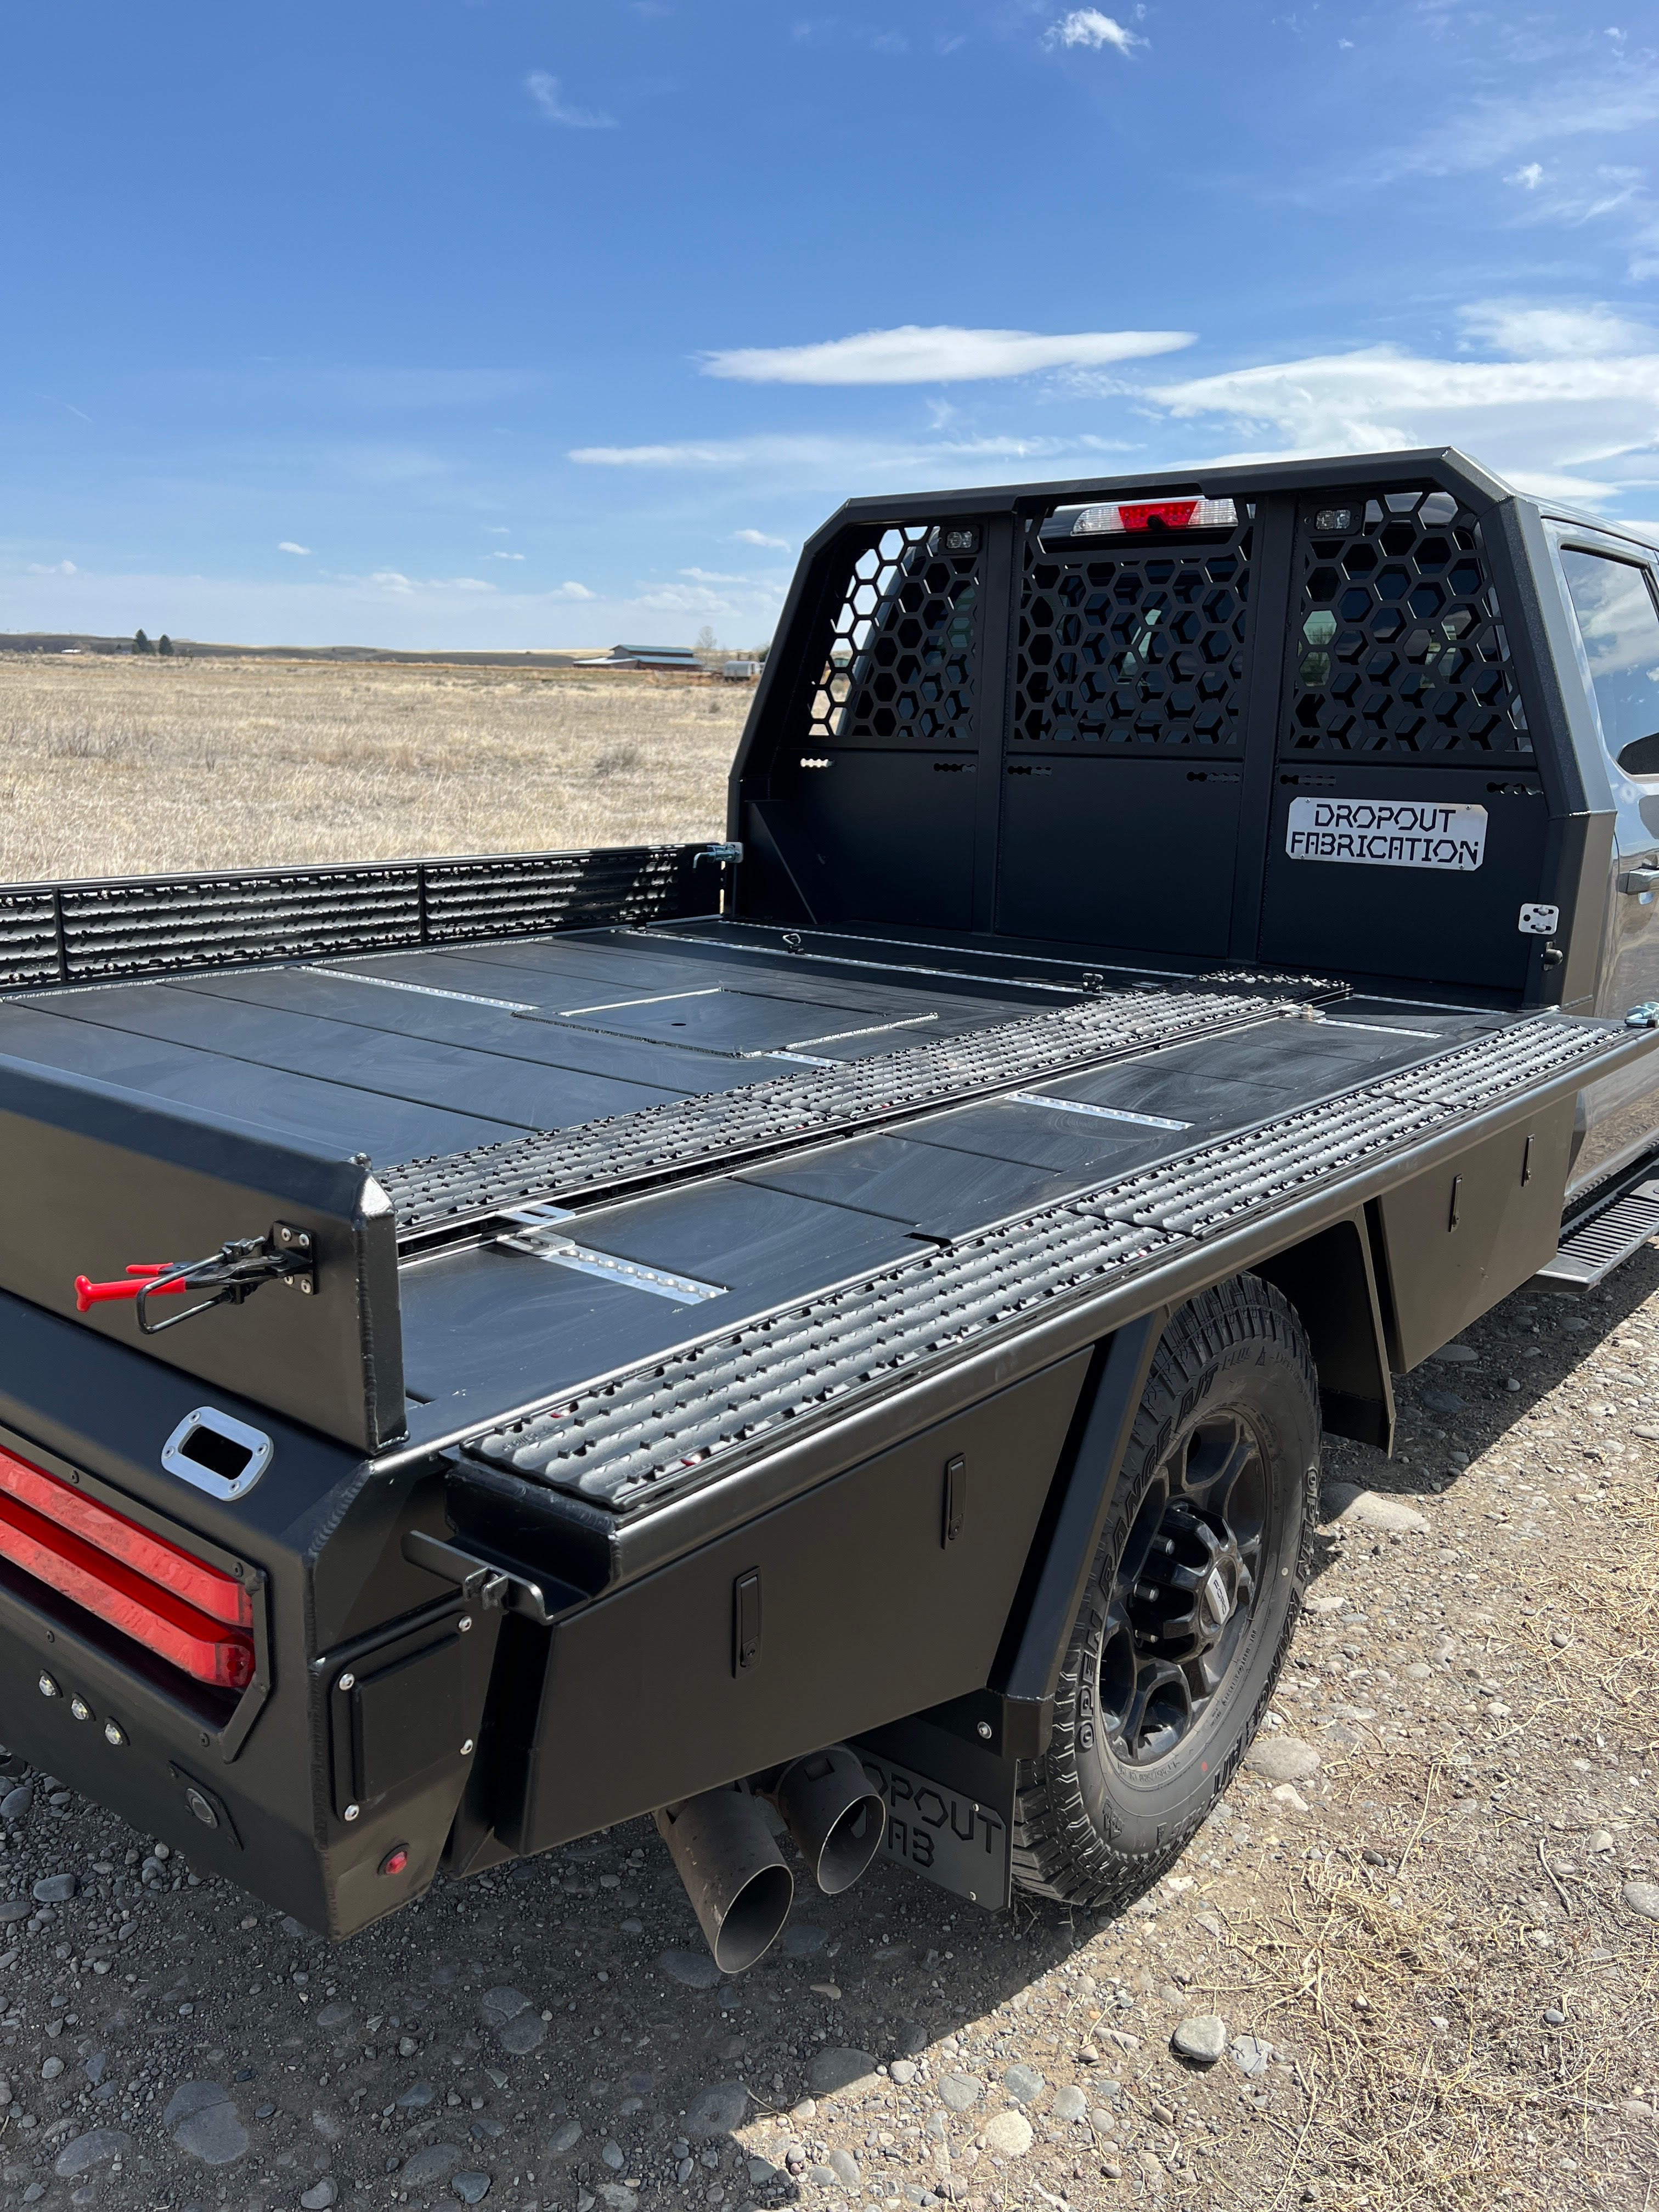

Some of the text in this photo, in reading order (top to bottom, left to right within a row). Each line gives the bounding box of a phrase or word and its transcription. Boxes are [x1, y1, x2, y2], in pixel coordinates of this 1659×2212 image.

[1315, 804, 1456, 833] DROPOUT
[1290, 831, 1479, 865] FABRICATION
[1294, 1465, 1319, 1583] OPEN
[1214, 1579, 1227, 1615] FORD
